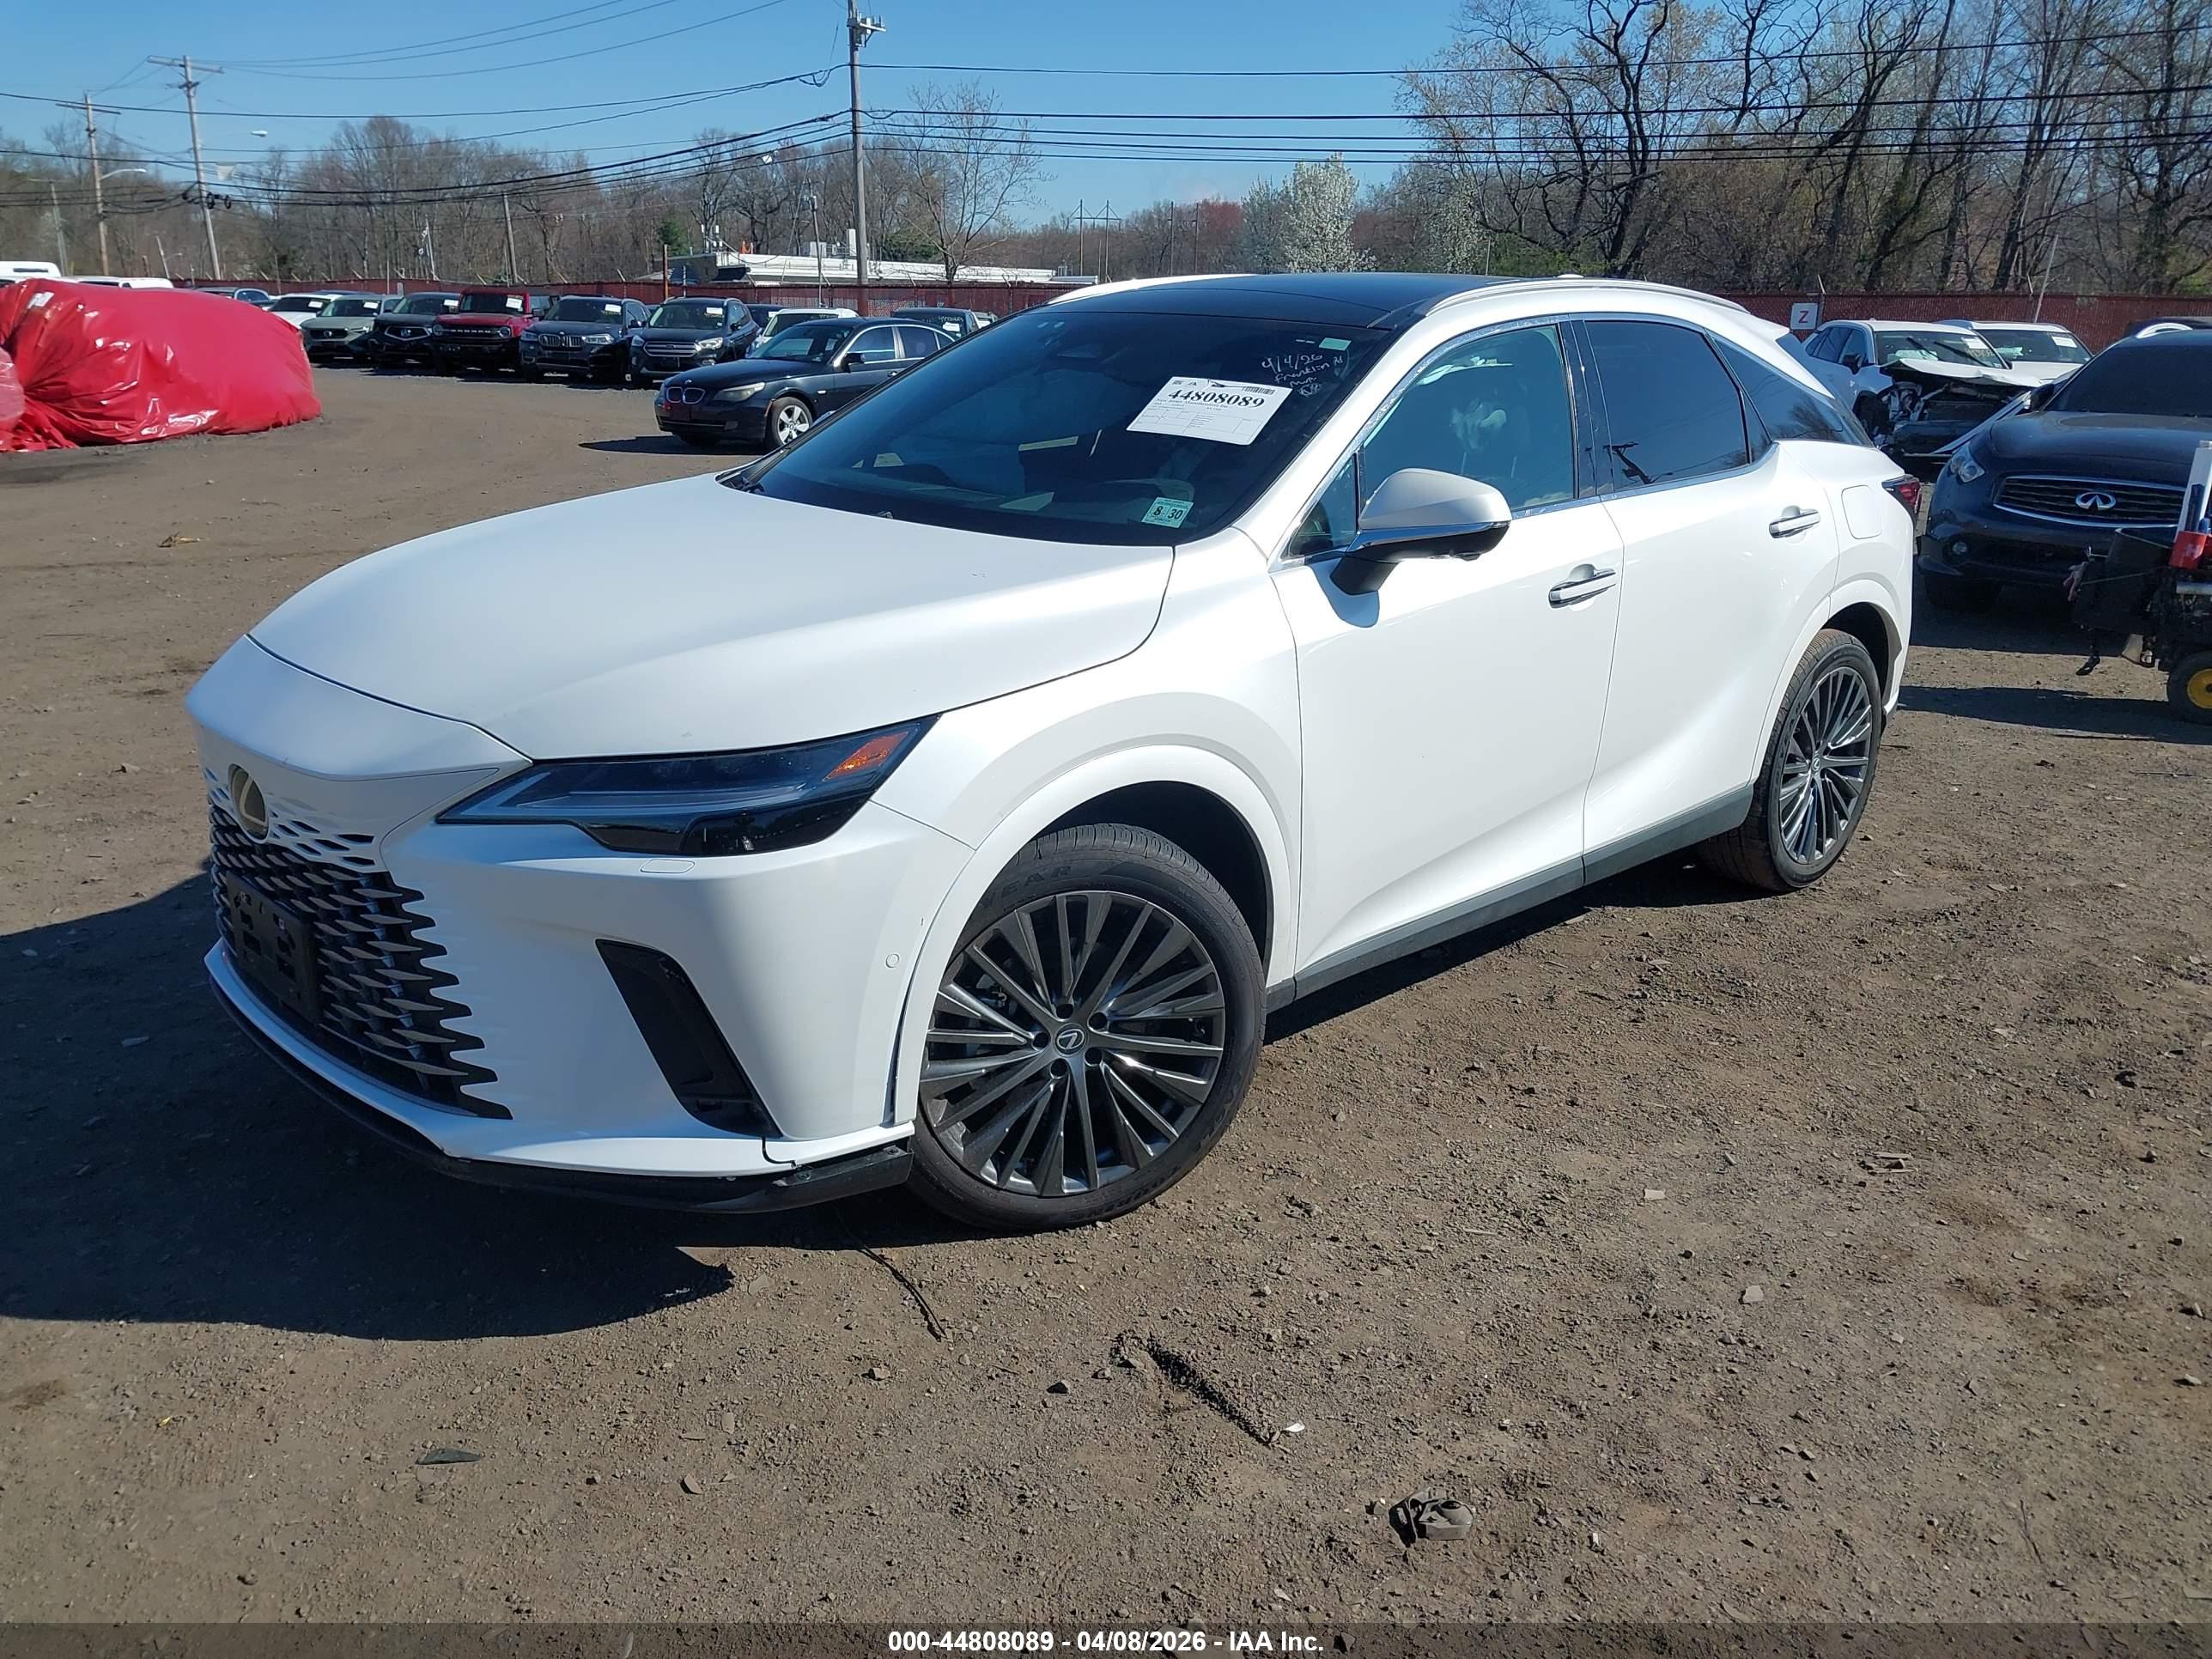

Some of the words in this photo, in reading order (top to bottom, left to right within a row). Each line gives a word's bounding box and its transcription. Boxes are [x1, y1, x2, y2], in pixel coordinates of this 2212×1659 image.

[1798, 310, 1809, 324] Z
[1168, 389, 1265, 409] 44808089
[1153, 506, 1164, 516] 8
[1168, 508, 1183, 520] 30
